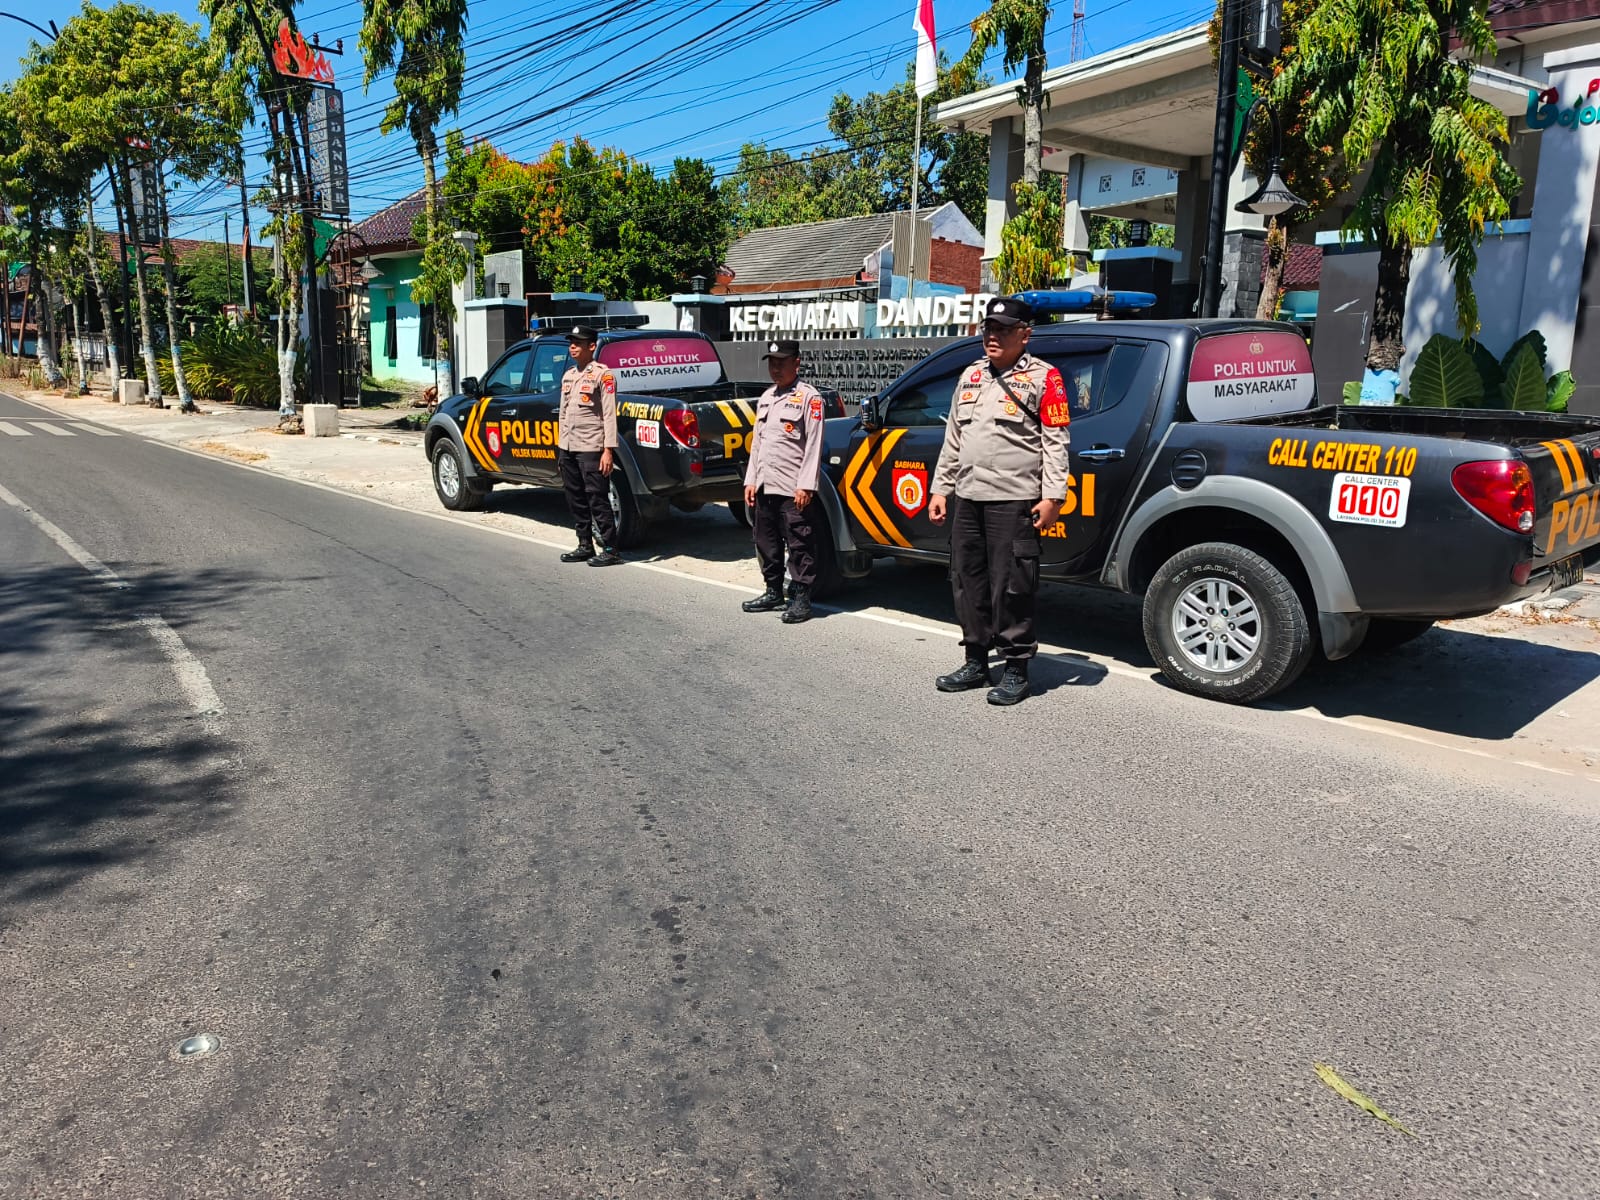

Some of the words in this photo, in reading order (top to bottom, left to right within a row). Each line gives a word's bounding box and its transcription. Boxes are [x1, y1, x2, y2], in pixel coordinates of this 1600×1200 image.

[331, 121, 345, 204] DANDER
[145, 177, 157, 236] DANDER
[729, 300, 864, 332] KECAMATAN
[876, 293, 997, 328] DANDER
[619, 355, 657, 366] POLRI
[660, 353, 700, 364] UNTUK
[1214, 362, 1254, 377] POLRI
[1257, 359, 1297, 374] UNTUK
[620, 365, 701, 378] MASYARAKAT
[799, 363, 853, 378] ECAMATAN
[1214, 378, 1297, 398] MASYARAKAT
[650, 404, 664, 420] 110
[501, 420, 560, 446] POLISI
[894, 460, 925, 470] SABHARA
[1268, 438, 1308, 467] CALL
[1311, 441, 1381, 473] CENTER
[1384, 445, 1417, 477] 110
[1344, 475, 1365, 484] CALL
[1366, 477, 1399, 486] CENTER
[1341, 486, 1398, 516] 110
[1192, 564, 1247, 584] RADIAL
